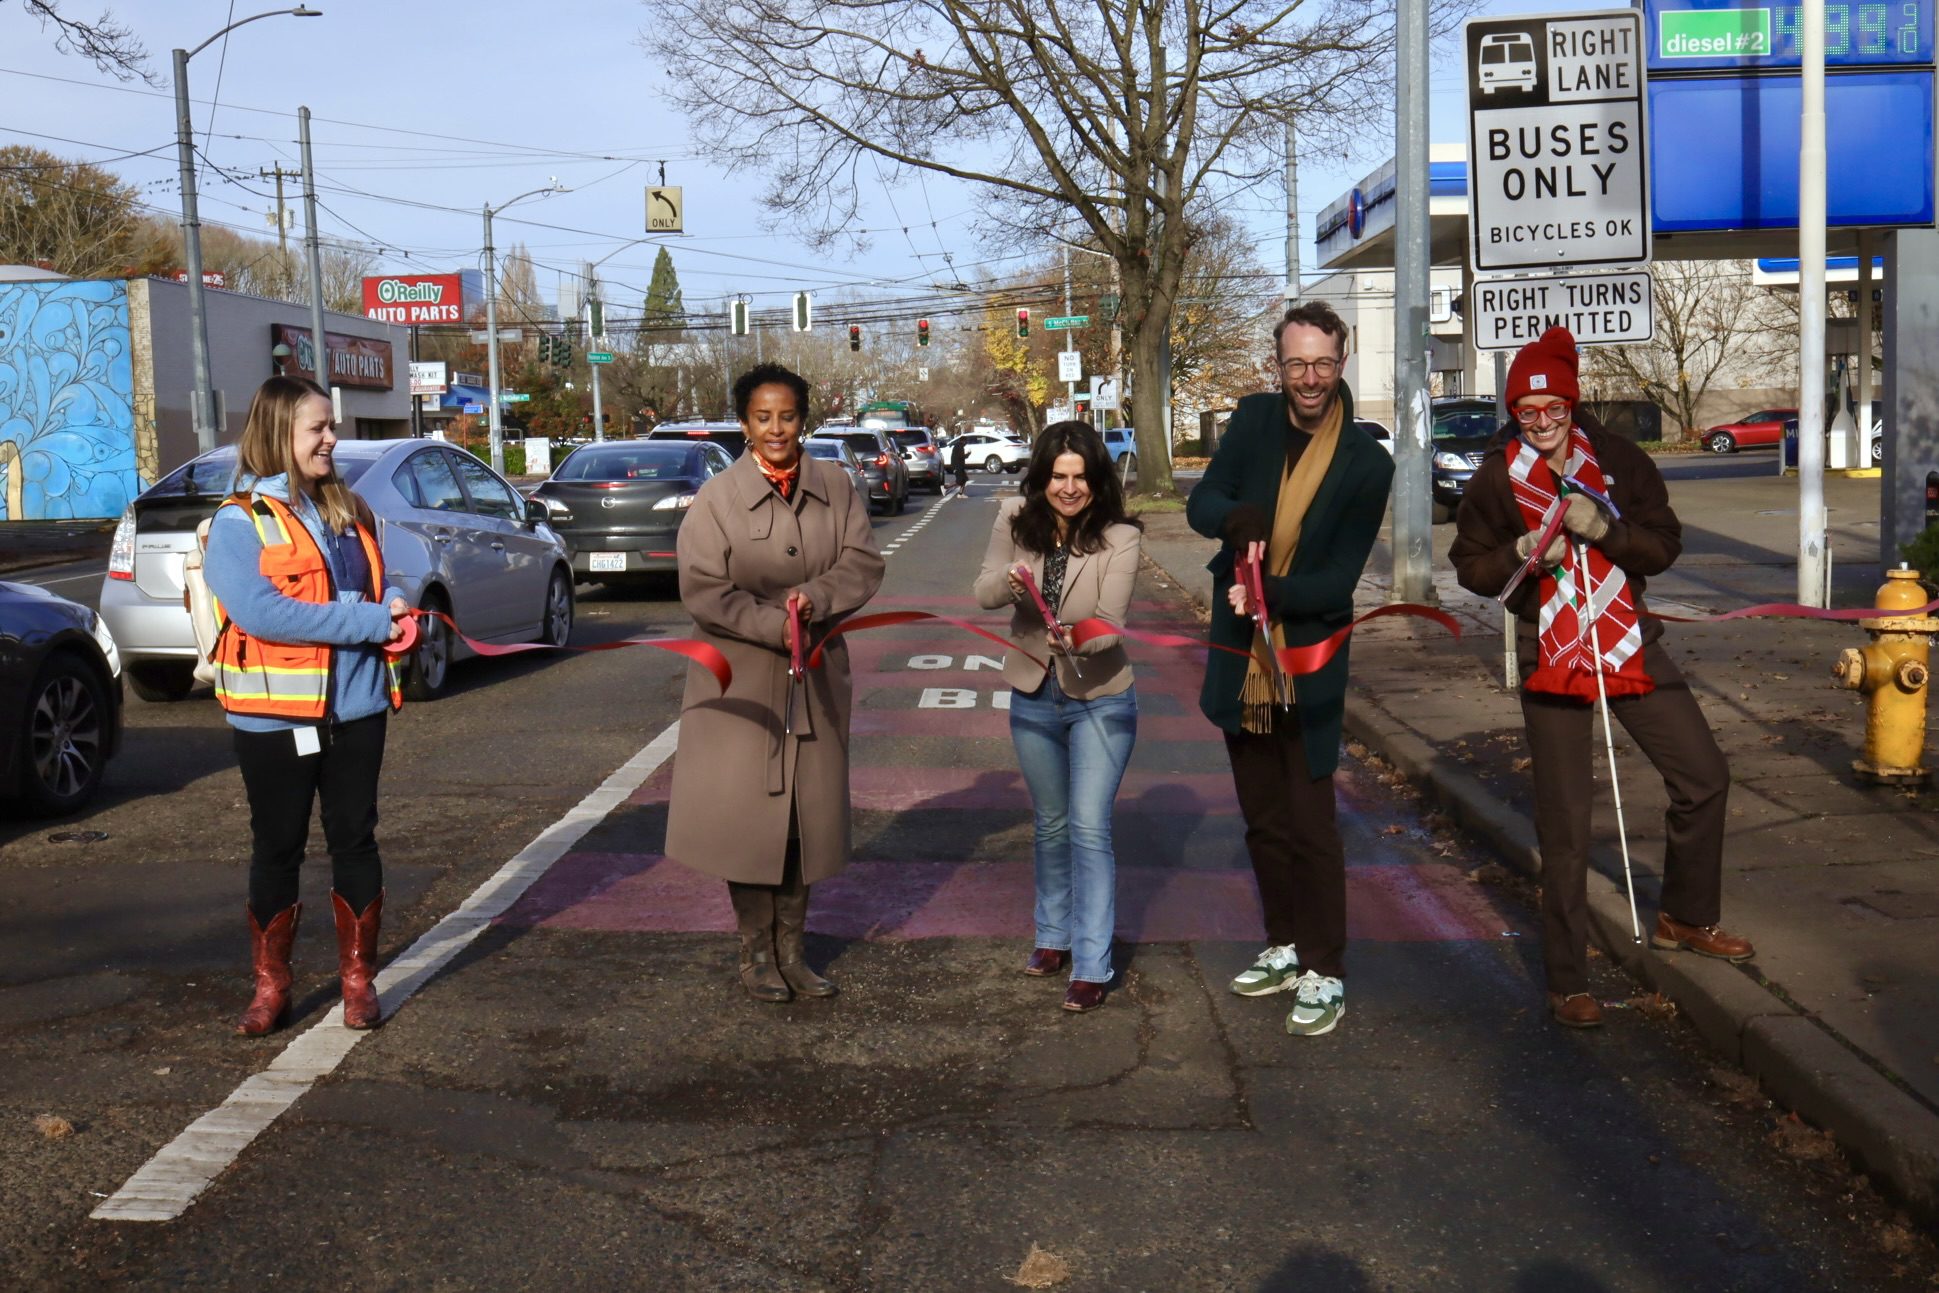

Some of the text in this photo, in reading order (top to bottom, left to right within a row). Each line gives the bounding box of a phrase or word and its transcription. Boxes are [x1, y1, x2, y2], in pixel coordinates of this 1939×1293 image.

[1552, 28, 1632, 58] RIGHT
[1667, 31, 1764, 53] diesel #2
[1558, 63, 1630, 92] LANE
[1489, 121, 1629, 160] BUSES
[1503, 163, 1616, 201] ONLY
[652, 218, 675, 228] ONLY
[1491, 219, 1633, 243] BICYCLES OK
[378, 280, 443, 304] O'Reilly
[1483, 282, 1642, 312] RIGHT TURNS
[368, 305, 459, 322] AUTO PARTS
[1495, 310, 1632, 339] PERMITTED
[335, 353, 357, 376] AUTO
[359, 355, 384, 378] PARTS
[907, 655, 1006, 671] ON
